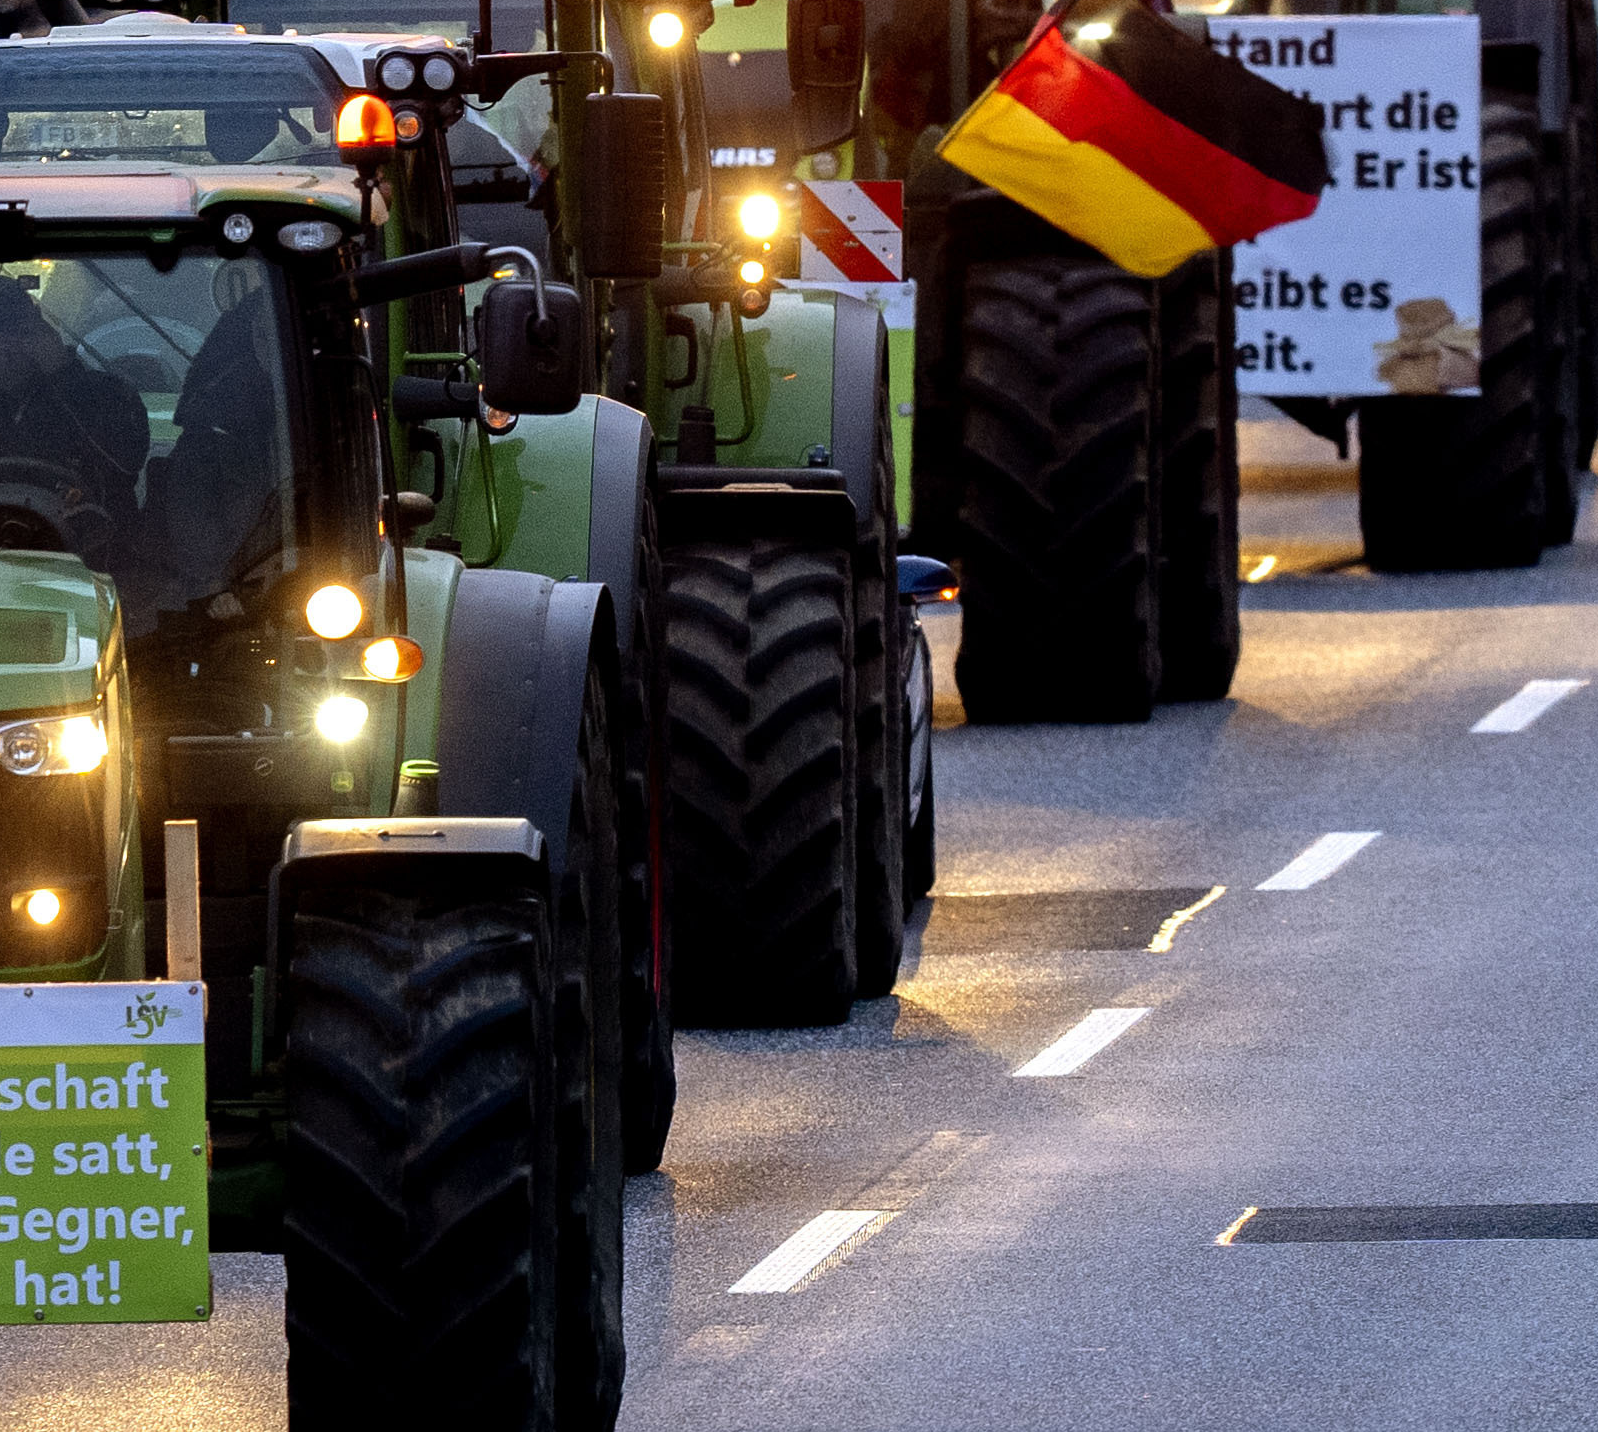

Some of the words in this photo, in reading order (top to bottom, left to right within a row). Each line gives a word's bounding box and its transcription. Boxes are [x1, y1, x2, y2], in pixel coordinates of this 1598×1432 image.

[1386, 90, 1459, 131] die
[1355, 151, 1405, 189] Er
[1417, 148, 1477, 190] ist
[1234, 268, 1328, 310] eibt
[1340, 279, 1392, 310] es
[1237, 330, 1315, 373] eit.
[52, 1133, 172, 1181] satt,
[13, 1259, 122, 1307] hat!
